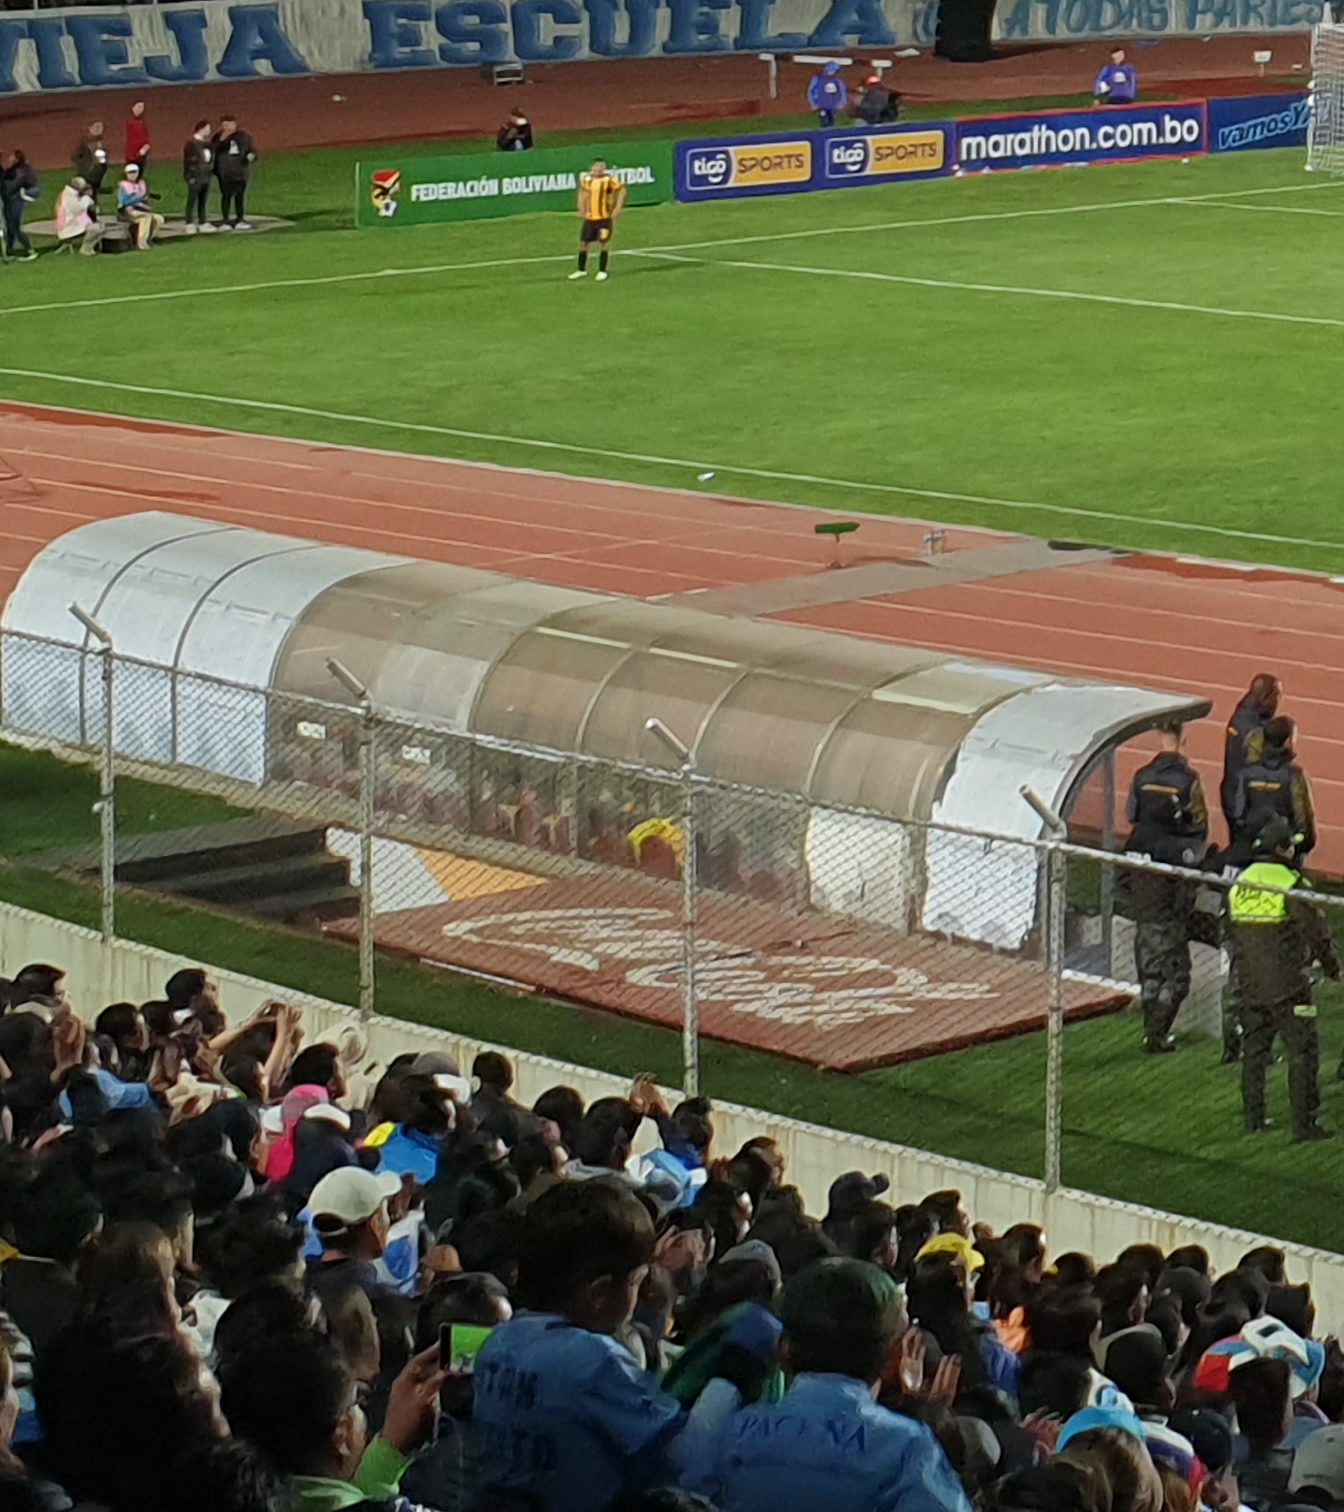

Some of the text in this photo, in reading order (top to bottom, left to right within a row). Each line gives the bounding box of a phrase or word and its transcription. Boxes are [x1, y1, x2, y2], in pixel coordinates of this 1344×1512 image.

[960, 114, 1199, 161] marathon.com.bo
[737, 151, 805, 175] SPORTS
[874, 141, 938, 163] SPORTS
[410, 175, 499, 202] FEDERACIÓN
[502, 173, 576, 196] BOLIVIANA
